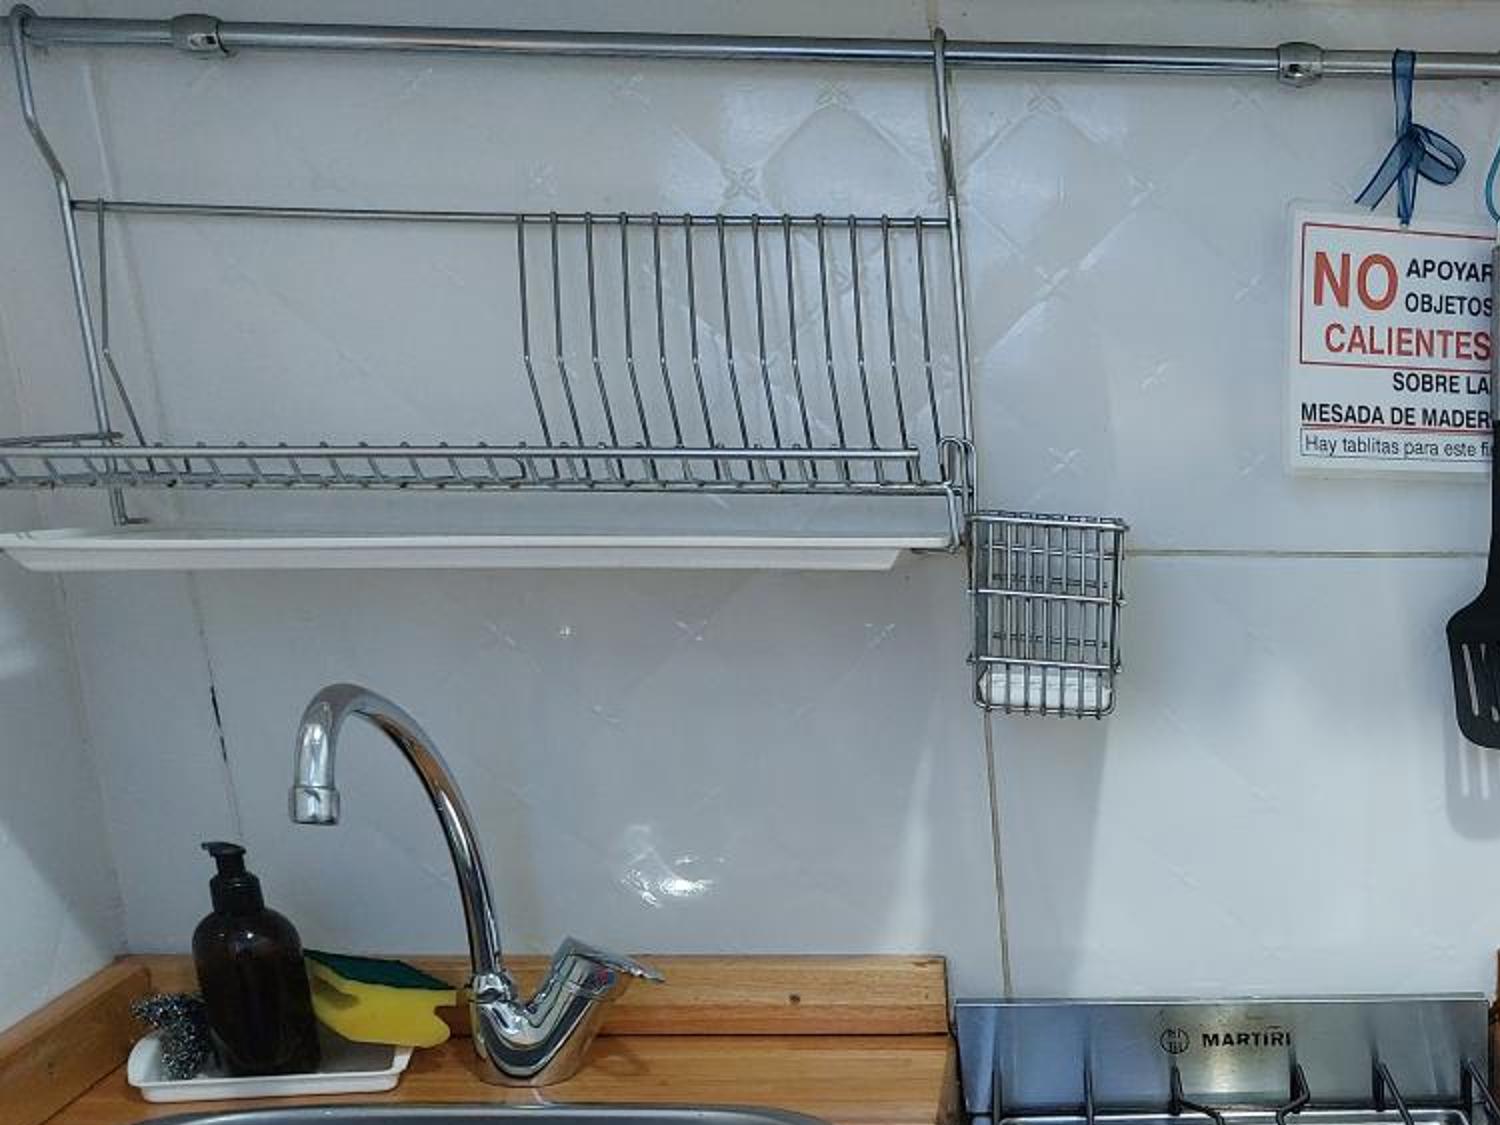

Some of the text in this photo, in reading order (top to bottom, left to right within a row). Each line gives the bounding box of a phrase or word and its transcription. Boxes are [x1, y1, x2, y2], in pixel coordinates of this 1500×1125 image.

[1313, 251, 1398, 311] NO
[1406, 258, 1493, 282] APOYAR
[1405, 292, 1493, 317] OBJETOS
[1324, 323, 1492, 361] CALIENTES
[1393, 372, 1489, 394] SOBRE LA
[1301, 403, 1494, 429] MESADA DE MADER
[1305, 435, 1337, 455] Hay
[1342, 437, 1399, 455] tablitas
[1403, 442, 1440, 459] para
[1443, 442, 1477, 457] este
[1202, 1032, 1291, 1047] MARTIRI
